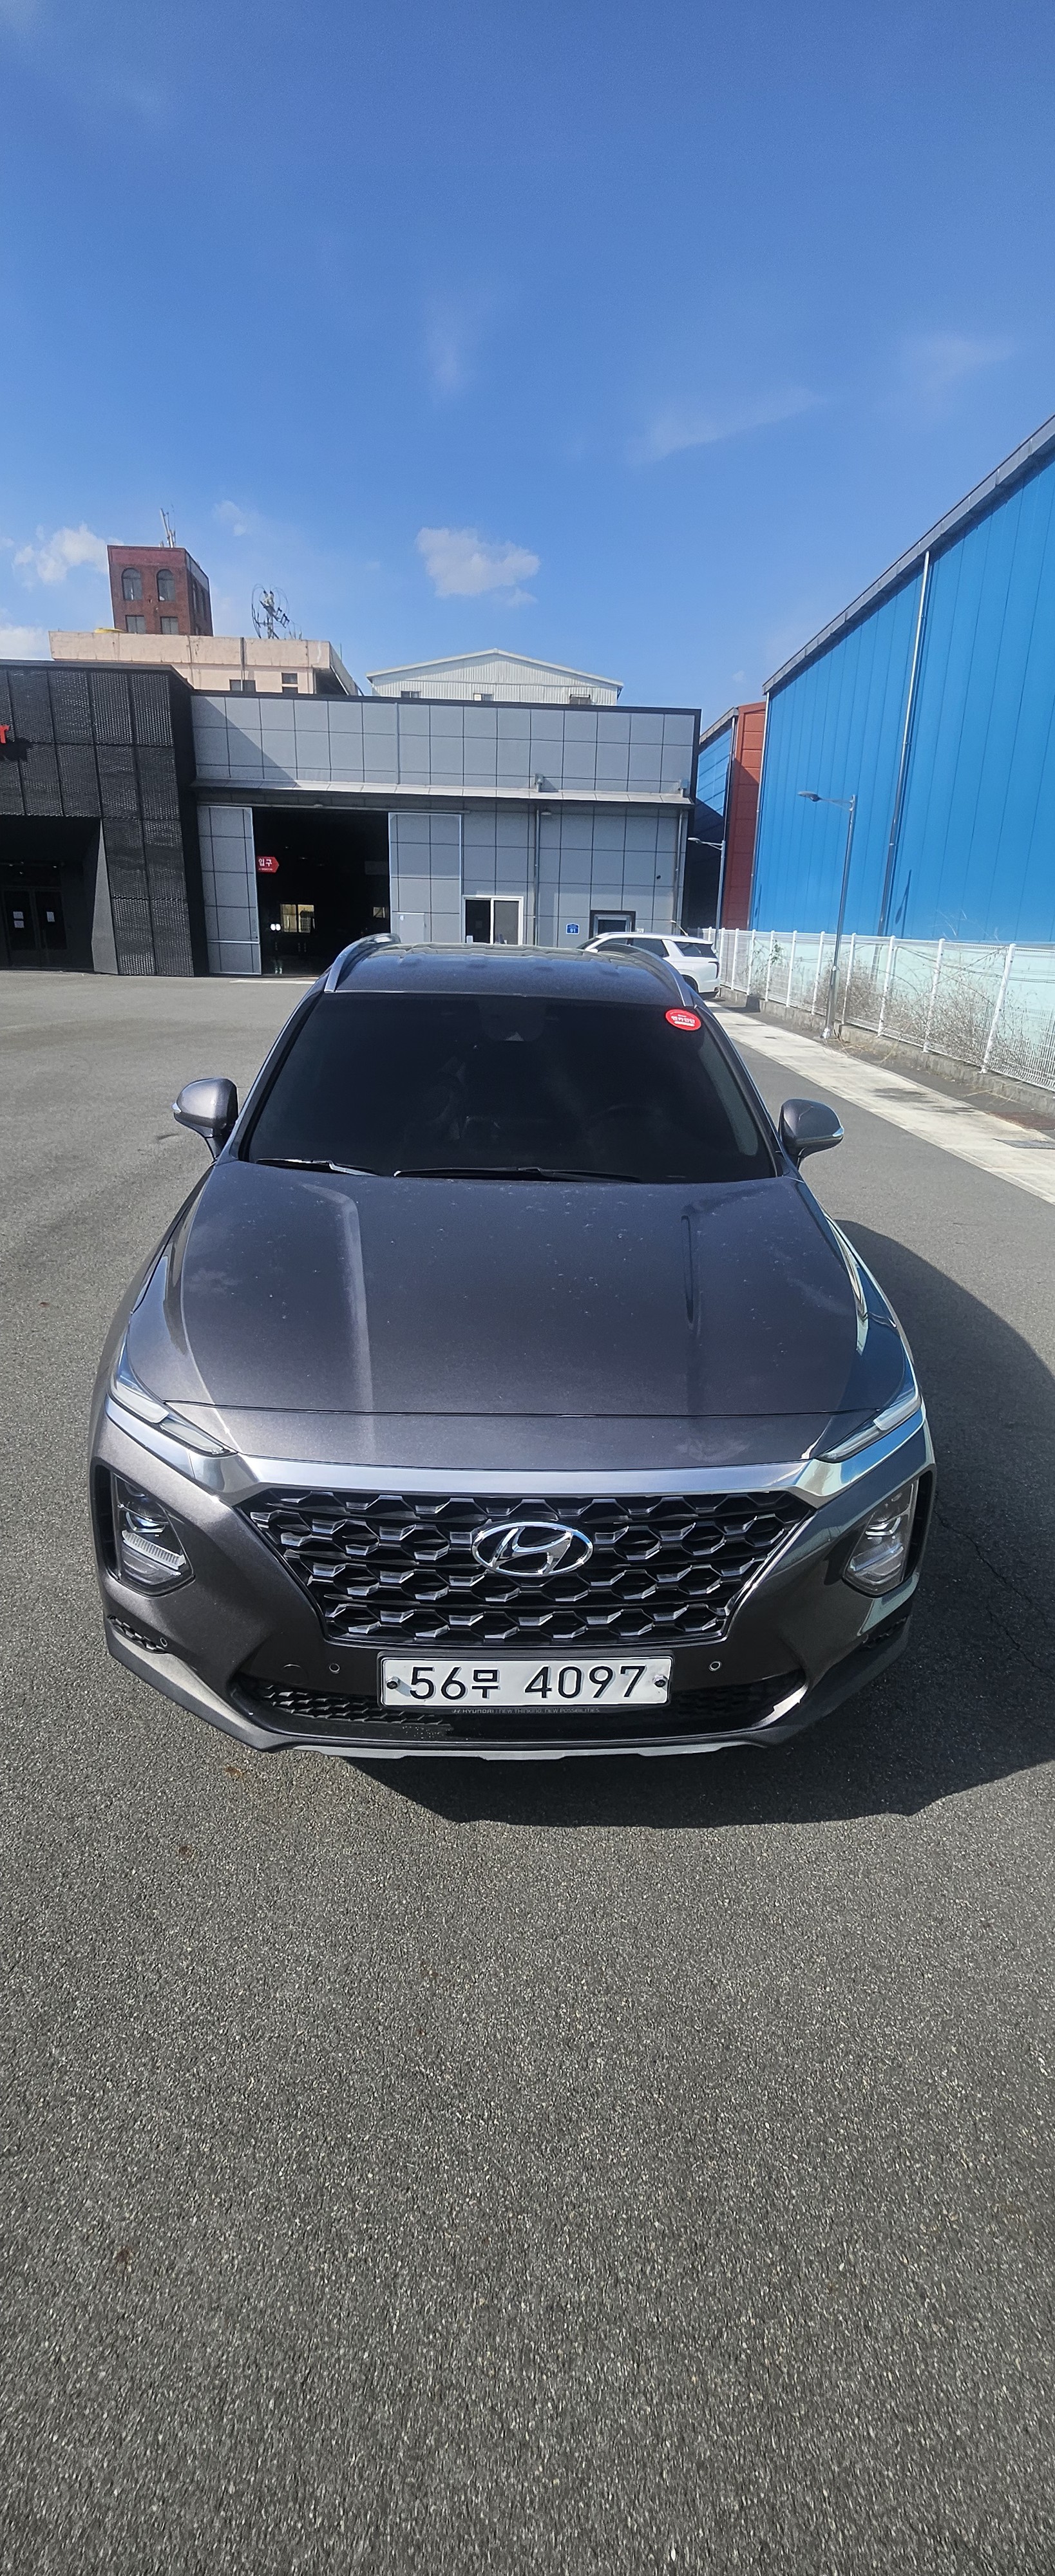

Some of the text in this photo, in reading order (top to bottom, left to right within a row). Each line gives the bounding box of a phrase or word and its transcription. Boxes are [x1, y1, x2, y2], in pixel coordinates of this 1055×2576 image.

[258, 858, 272, 867] 입구
[410, 1665, 647, 1700] 56무 4097
